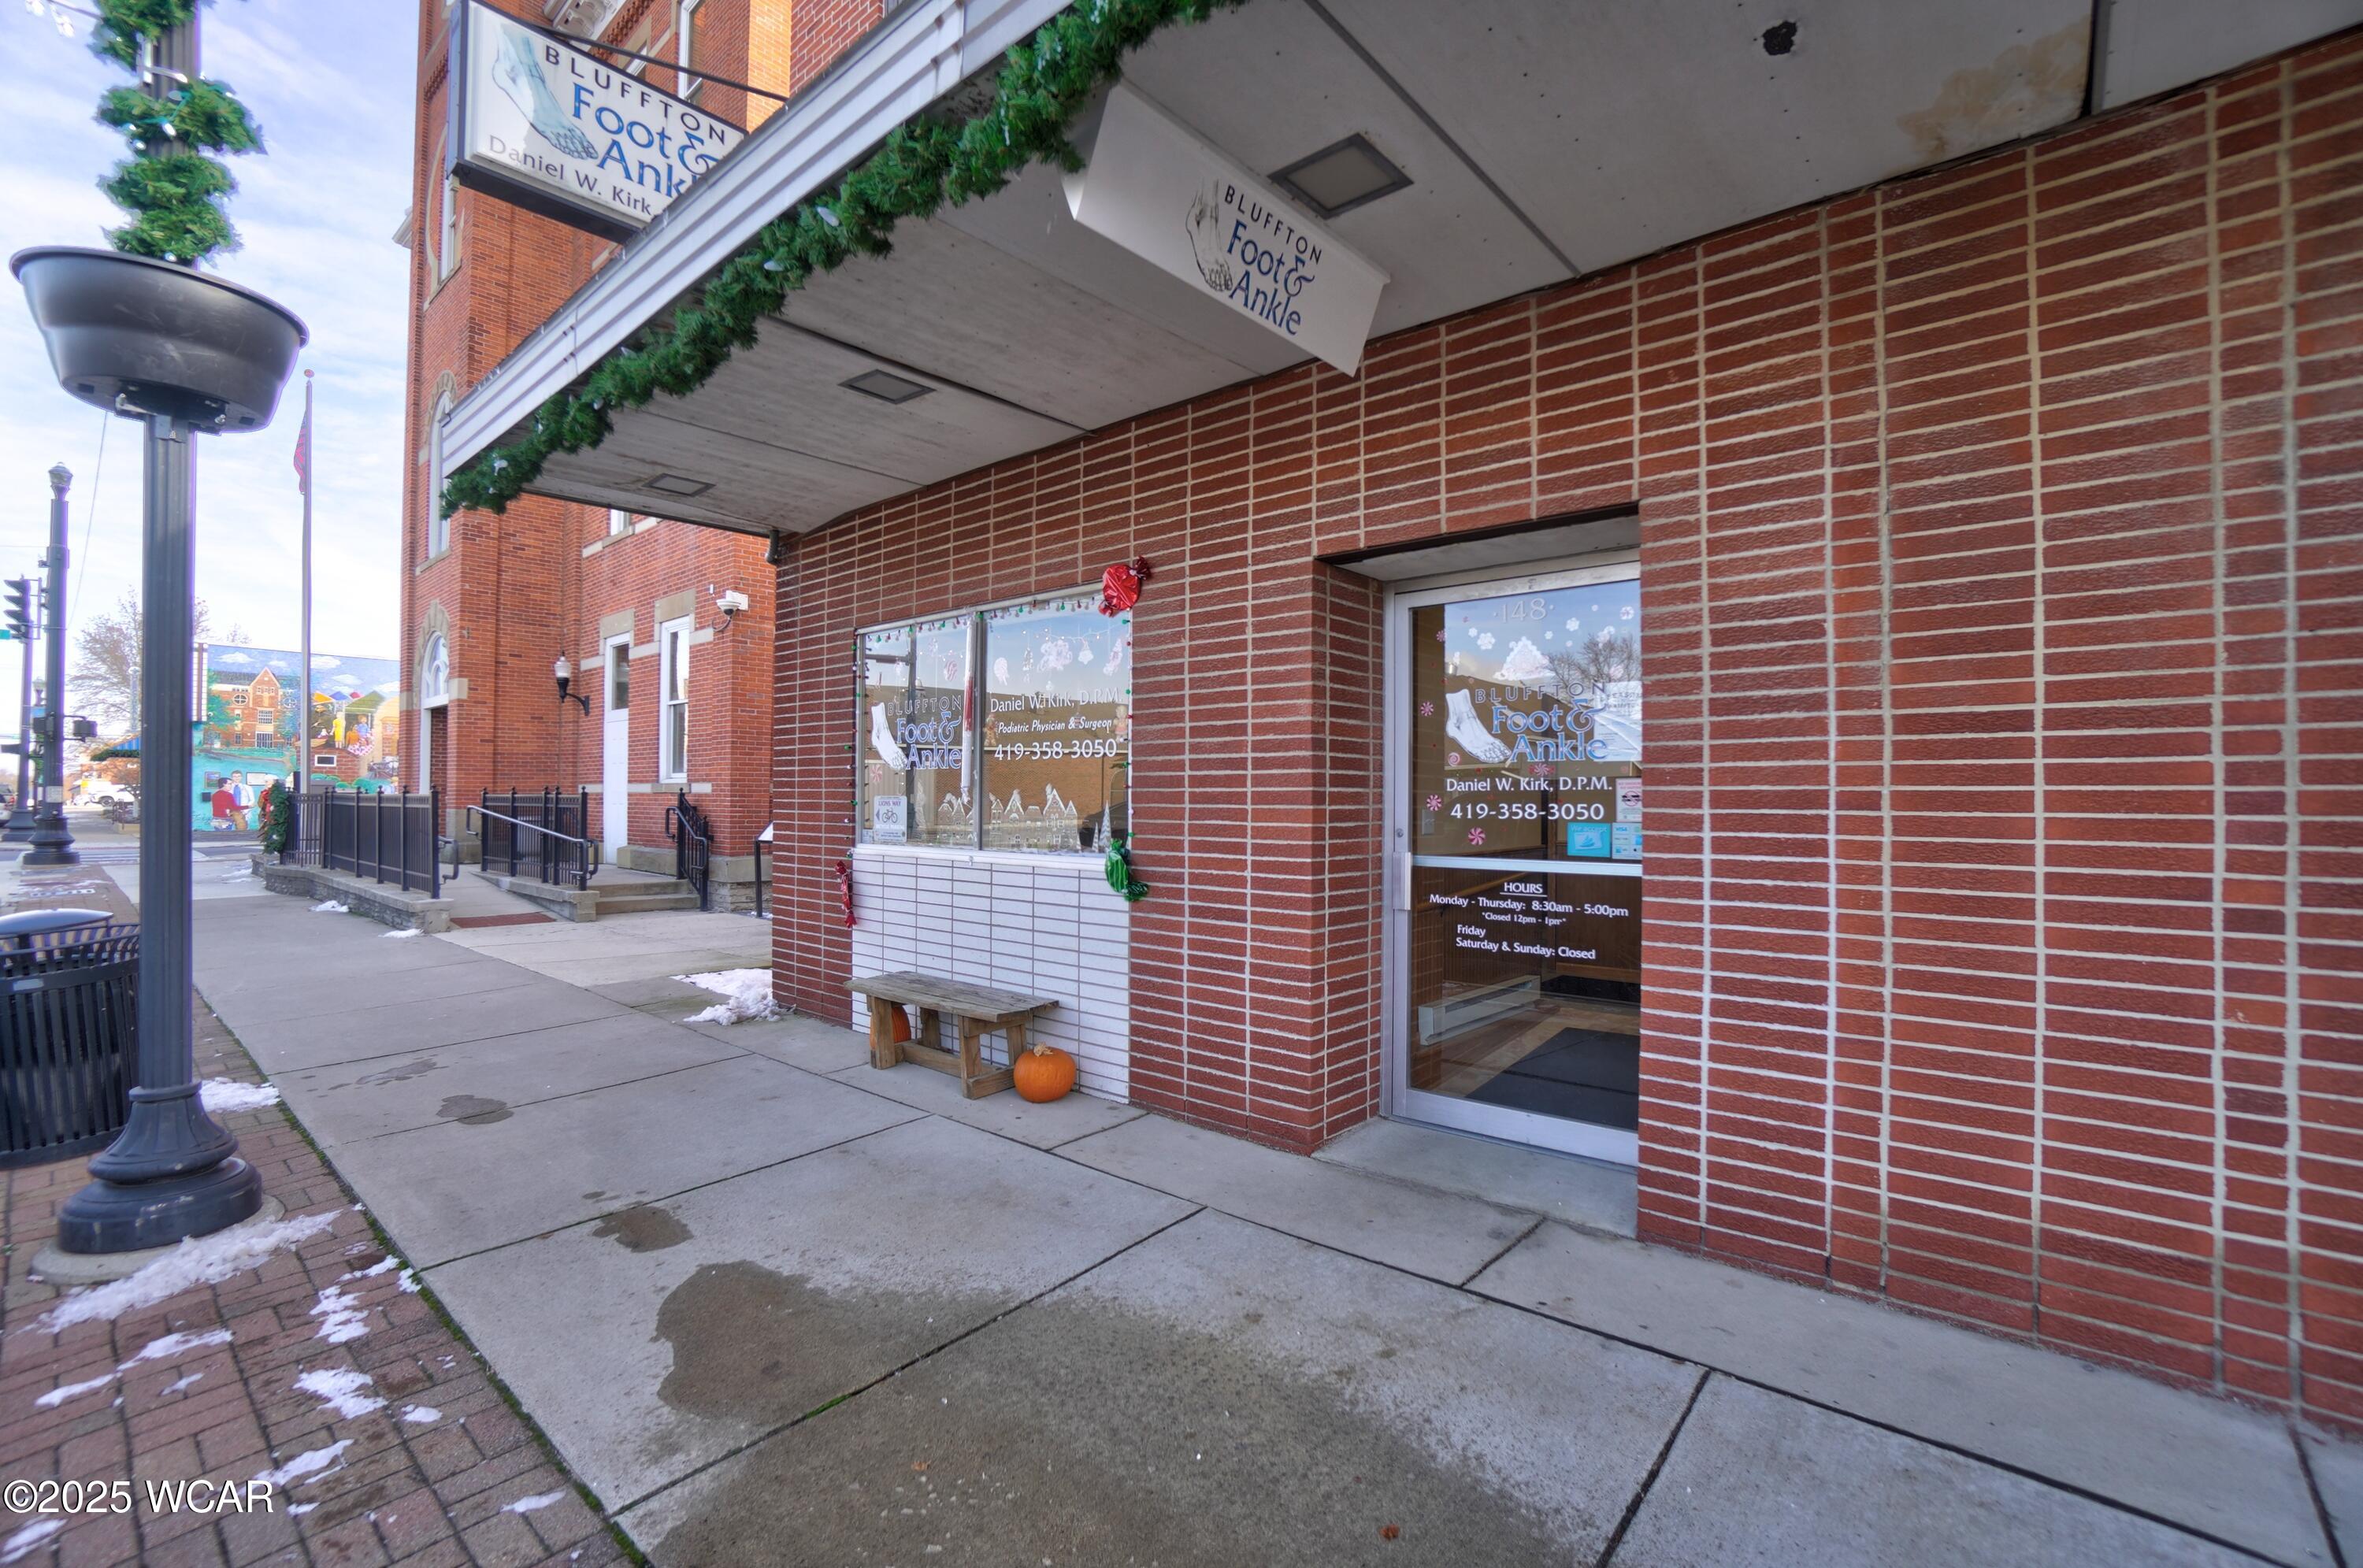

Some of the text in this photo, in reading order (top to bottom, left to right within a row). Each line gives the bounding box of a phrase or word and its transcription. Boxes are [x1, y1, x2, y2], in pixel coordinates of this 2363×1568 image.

[545, 44, 725, 146] BLUFFTON
[573, 82, 720, 176] Foot &
[489, 135, 652, 216] Daniel W. Kirk
[597, 139, 698, 198] Ank
[1224, 184, 1322, 265] BLUFFTON
[1227, 219, 1315, 297] Foot &
[1229, 269, 1301, 335] Ankle
[1502, 598, 1547, 624] 148
[990, 696, 1024, 713] Daniel
[1048, 691, 1075, 708] Kirk,
[1079, 687, 1122, 706] D.P.M.
[1475, 681, 1606, 703] BLUFFTON
[887, 695, 962, 716] BLUFFTON
[1492, 698, 1607, 734] Foot &
[896, 711, 963, 743] Foot &
[998, 716, 1112, 736] Podiatric Physician & Surgeon
[905, 743, 962, 769] Ankle
[994, 738, 1117, 761] 419-358-3050
[1508, 732, 1608, 762] Ankle
[1446, 777, 1490, 791] Daniel
[1495, 778, 1514, 791] W.
[1519, 777, 1553, 794] Kirk,
[1559, 776, 1612, 791] D.P.M.
[1450, 803, 1604, 820] 419-358-3050
[1504, 882, 1544, 894] HOURS
[1430, 894, 1469, 908] Monday
[1478, 897, 1526, 911] Thursday:
[1531, 900, 1573, 913] 8:30am
[1584, 903, 1629, 917] 5:00pm
[1457, 924, 1486, 938] Friday
[1514, 914, 1536, 925] 12pm
[1456, 937, 1597, 959] Saturday & Sunday: Closed
